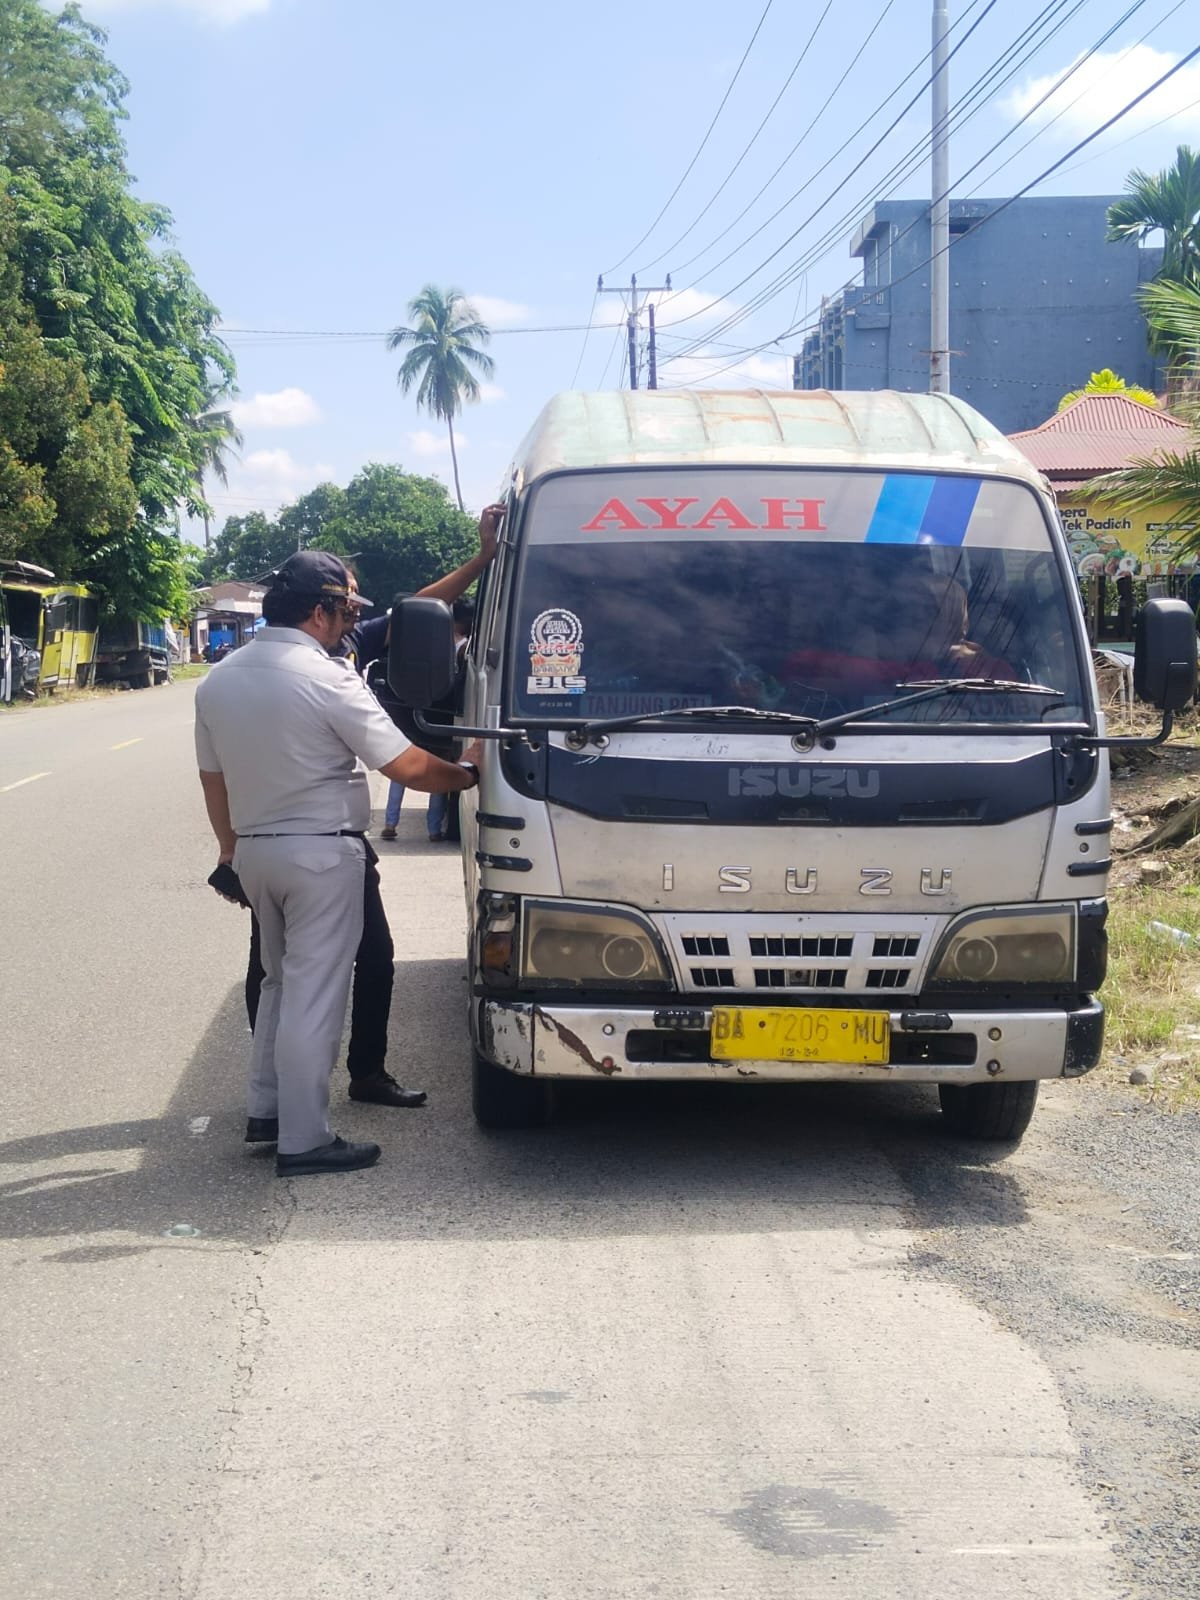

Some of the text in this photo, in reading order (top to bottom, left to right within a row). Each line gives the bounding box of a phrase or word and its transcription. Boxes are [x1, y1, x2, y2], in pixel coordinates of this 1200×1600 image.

[580, 497, 828, 531] AYAH
[587, 695, 664, 715] TANJUNG
[728, 767, 880, 798] ISUZU
[663, 864, 953, 895] ISUZU
[714, 1009, 886, 1045] BA 7206 MU
